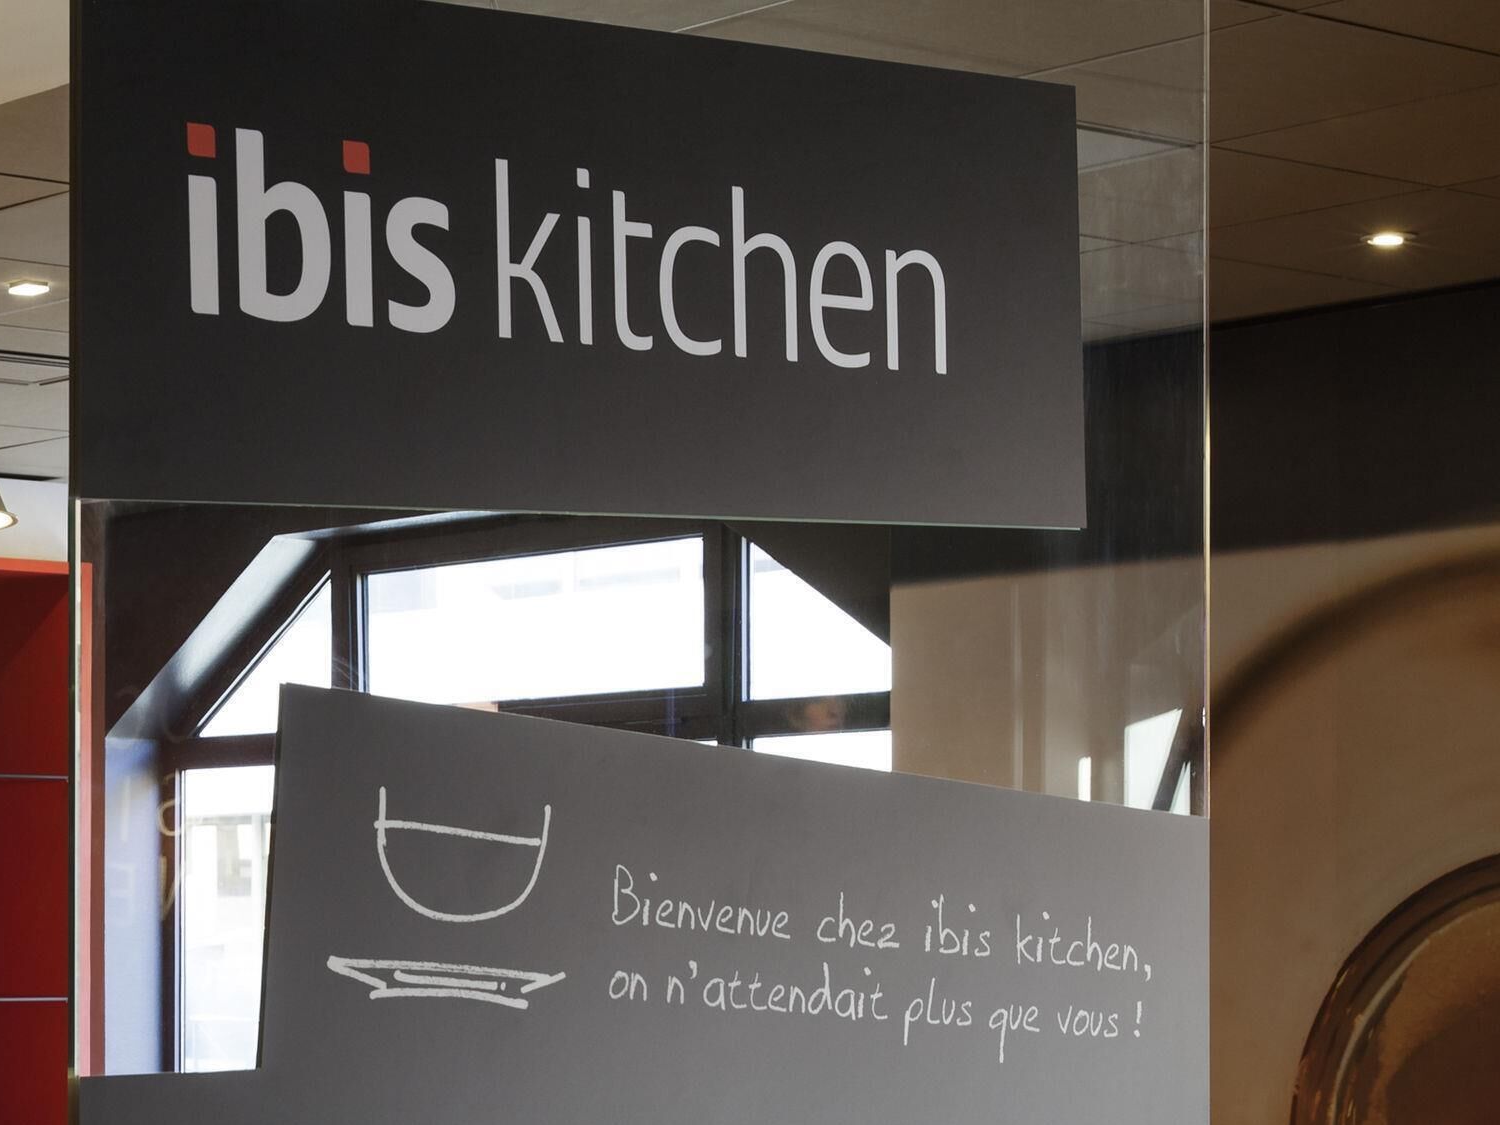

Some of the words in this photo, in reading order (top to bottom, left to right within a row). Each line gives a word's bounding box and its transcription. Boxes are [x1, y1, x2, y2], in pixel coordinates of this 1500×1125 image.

[187, 122, 457, 334] ibis
[494, 157, 948, 375] kitchen
[611, 863, 791, 940] Bienvenue
[816, 891, 901, 949] chez
[924, 893, 991, 957] ibis
[1016, 911, 1152, 982] kitchen,
[608, 970, 648, 1002] on
[666, 959, 889, 1021] n'attendait
[903, 977, 973, 1047] plus
[988, 1004, 1041, 1064] que
[1057, 1005, 1119, 1038] vous
